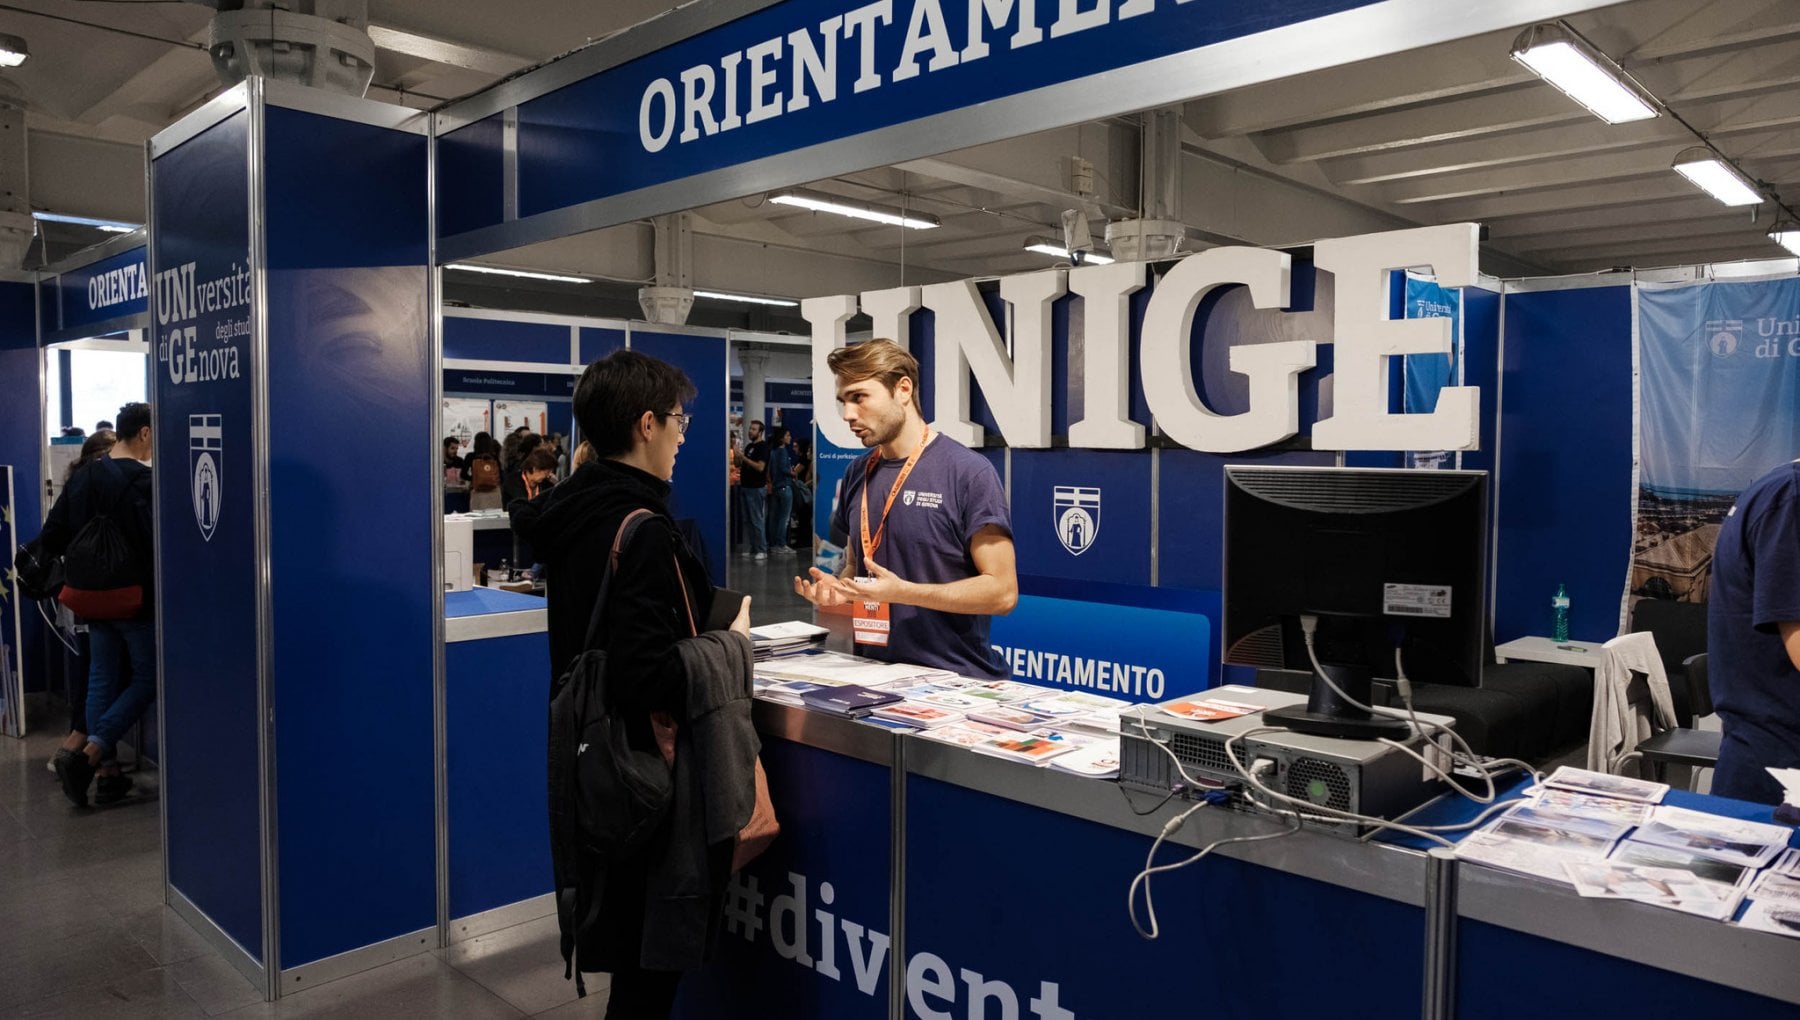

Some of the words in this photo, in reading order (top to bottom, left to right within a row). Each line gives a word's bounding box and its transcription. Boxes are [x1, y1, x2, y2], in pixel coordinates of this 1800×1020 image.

[639, 0, 1198, 153] ORIENTAM
[88, 261, 149, 310] ORIENTA
[159, 336, 168, 361] di
[169, 326, 240, 385] GEnova
[215, 320, 233, 343] degli
[801, 222, 1480, 452] UNIGE
[1755, 338, 1780, 358] di
[854, 620, 889, 629] ESPOSITORE
[991, 645, 1165, 699] IENTAMENTO
